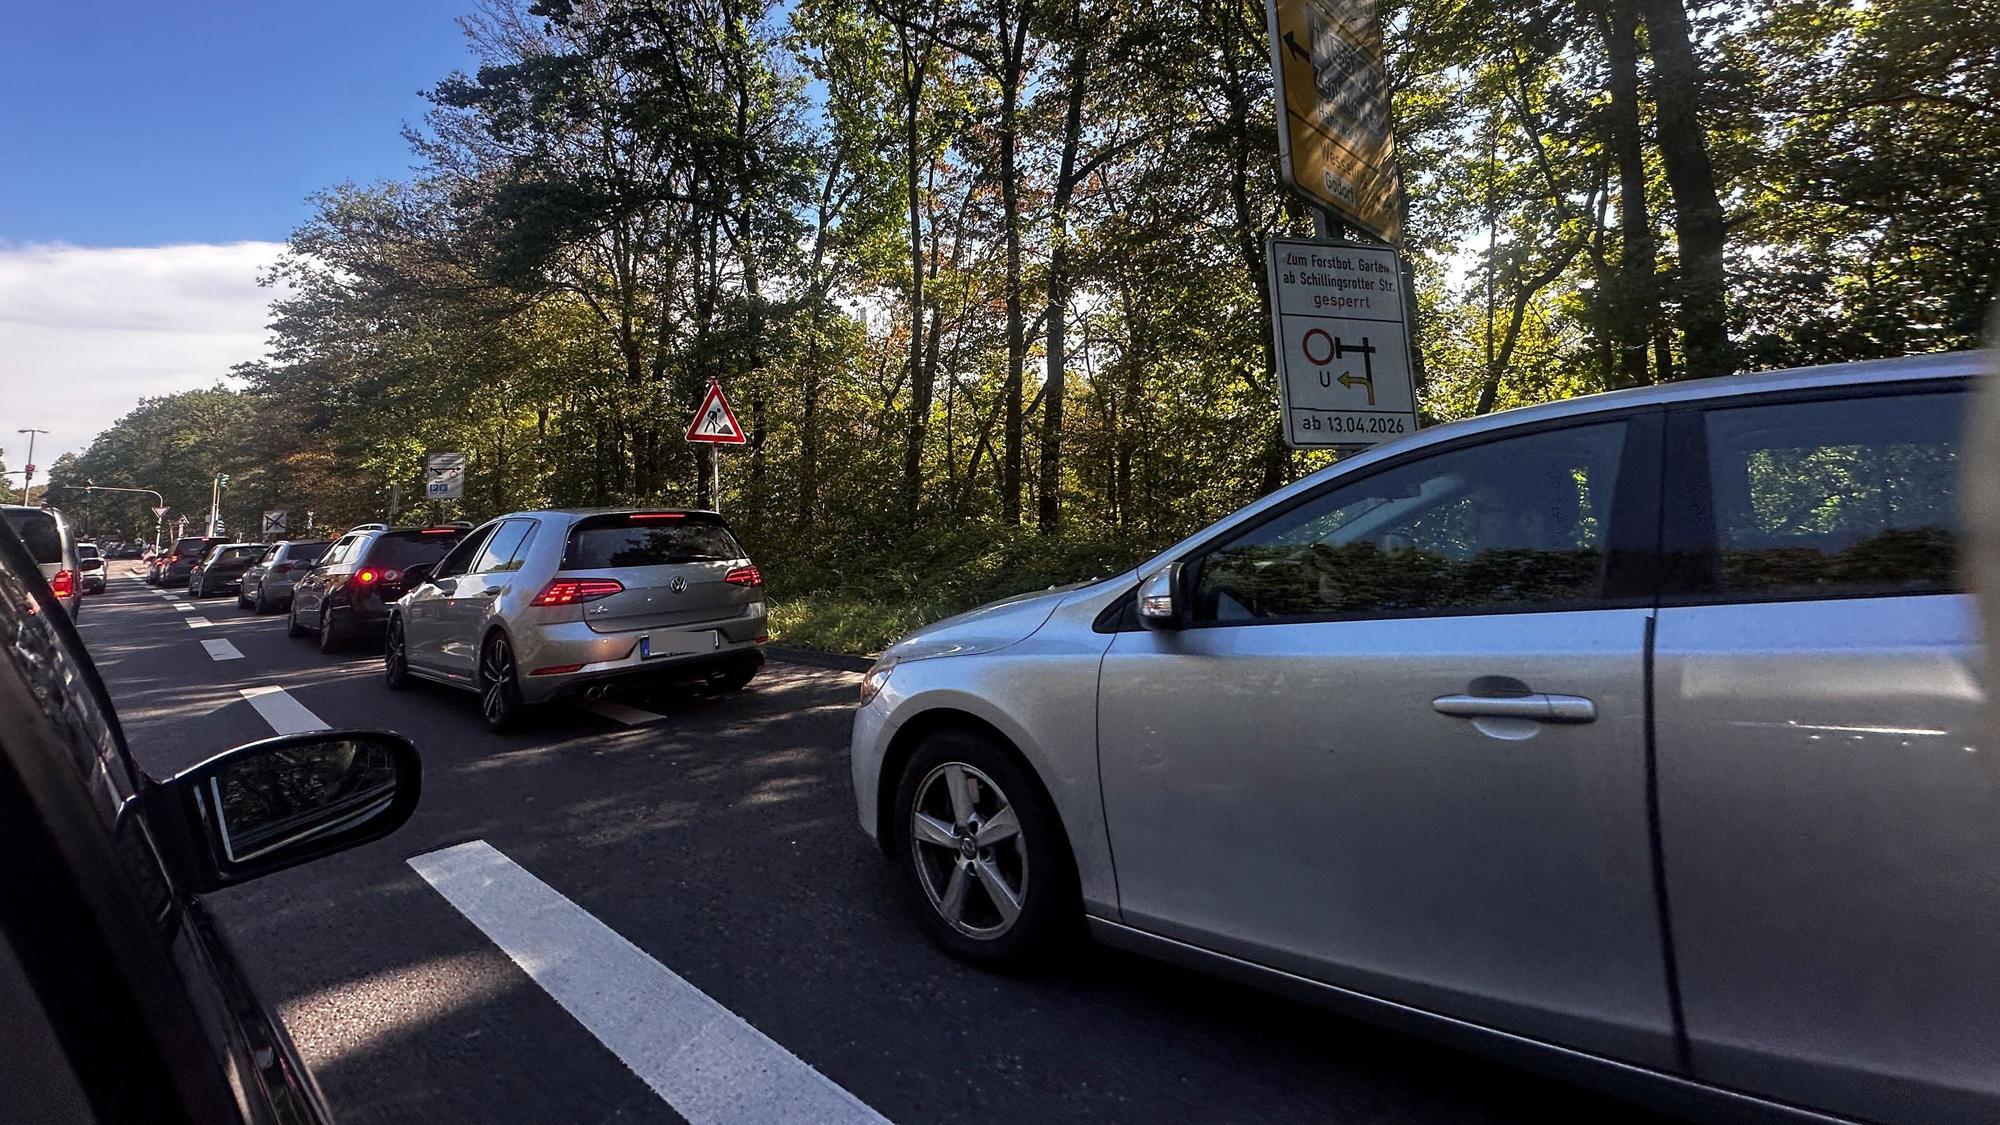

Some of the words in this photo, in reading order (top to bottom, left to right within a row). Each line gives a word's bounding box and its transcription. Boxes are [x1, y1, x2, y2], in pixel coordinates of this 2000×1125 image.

[1286, 252, 1307, 267] Zum
[1311, 254, 1354, 271] Forstbot.
[1283, 271, 1296, 284] ab
[1300, 272, 1375, 291] Schillingsrotter
[1379, 279, 1395, 292] Str.
[1314, 295, 1370, 310] gesperrt
[1319, 370, 1331, 388] U
[1302, 415, 1321, 430] ab
[1328, 416, 1405, 434] 13.04.2026
